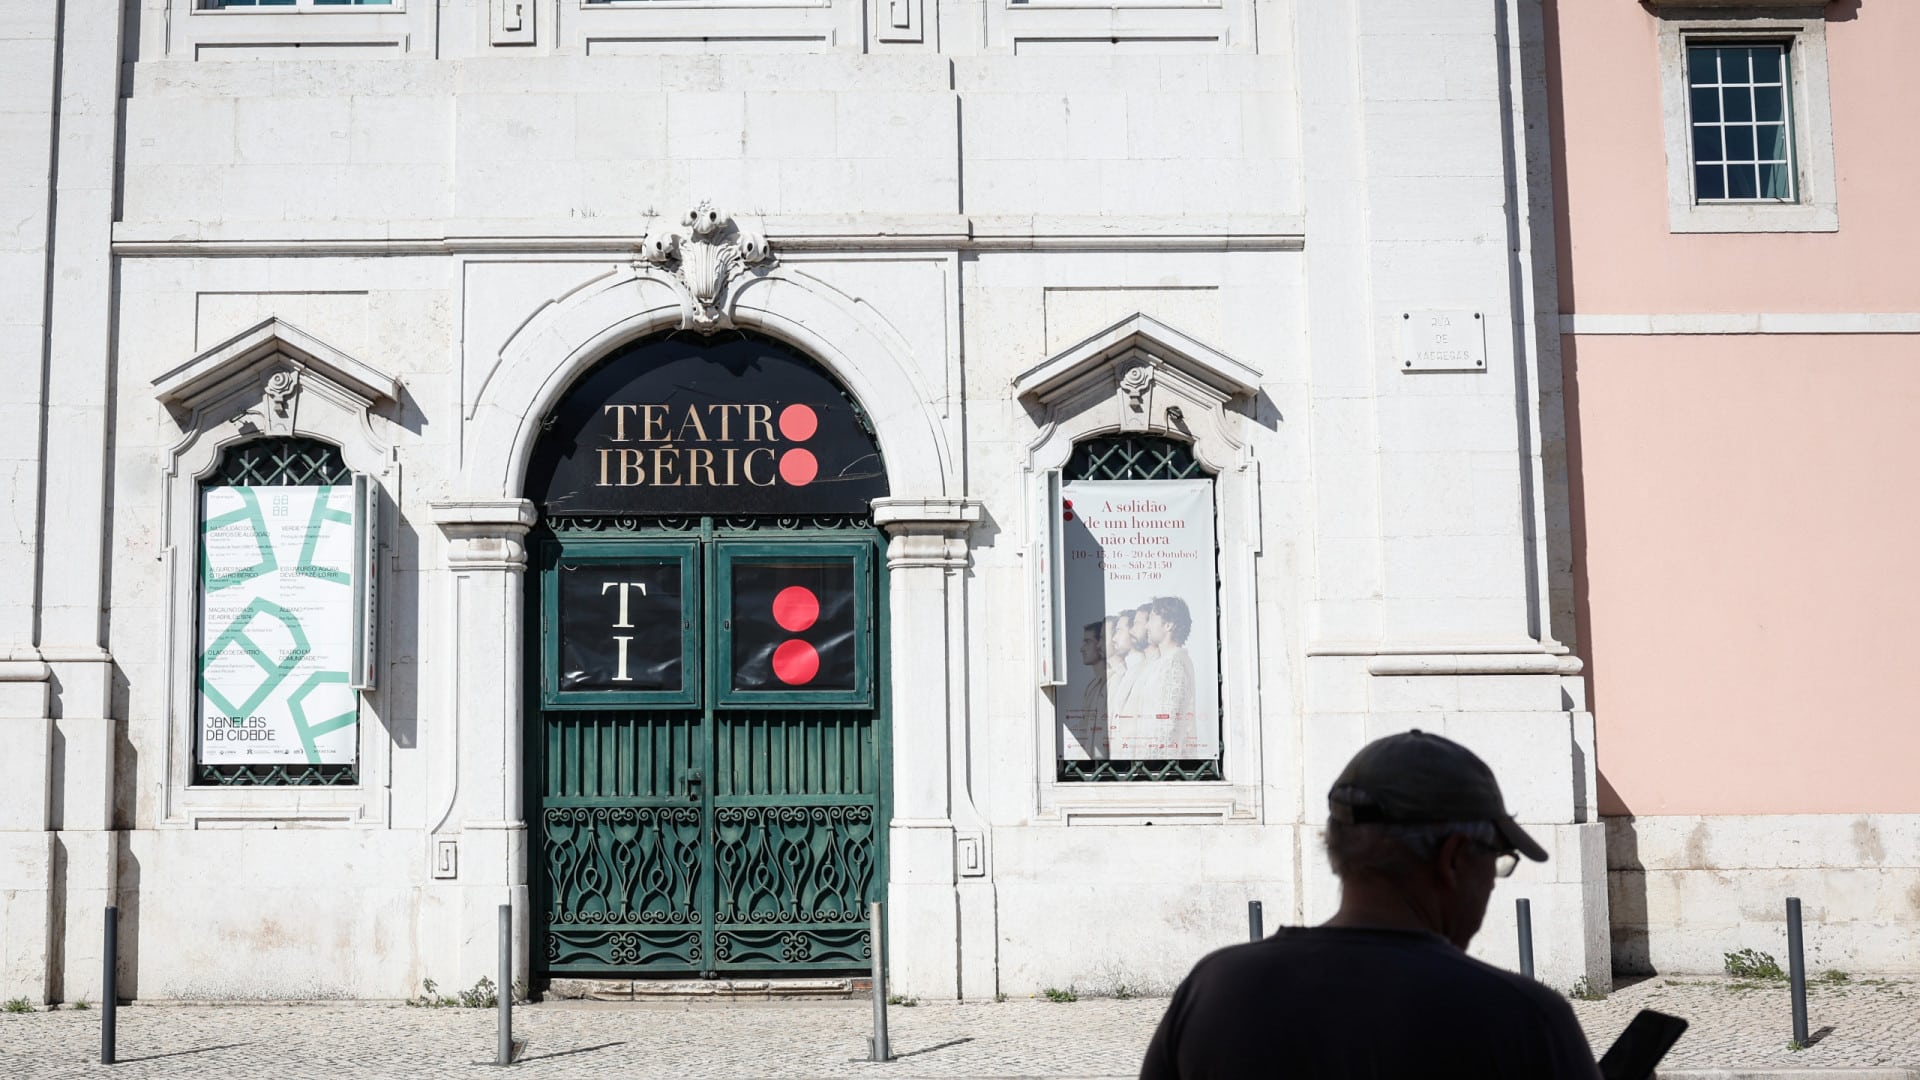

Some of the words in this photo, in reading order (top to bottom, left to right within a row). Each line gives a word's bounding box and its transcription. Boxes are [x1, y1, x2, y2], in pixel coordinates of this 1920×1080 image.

[1102, 501, 1113, 513] A
[1116, 500, 1167, 513] solidão
[1083, 516, 1100, 529] de
[1104, 519, 1128, 529] um
[1132, 516, 1185, 529] homem
[1100, 533, 1126, 545] não
[1129, 532, 1170, 545] chora
[1144, 550, 1156, 559] de
[206, 716, 267, 729] JANELAS
[206, 729, 224, 741] DA
[227, 729, 276, 741] CIDADE
